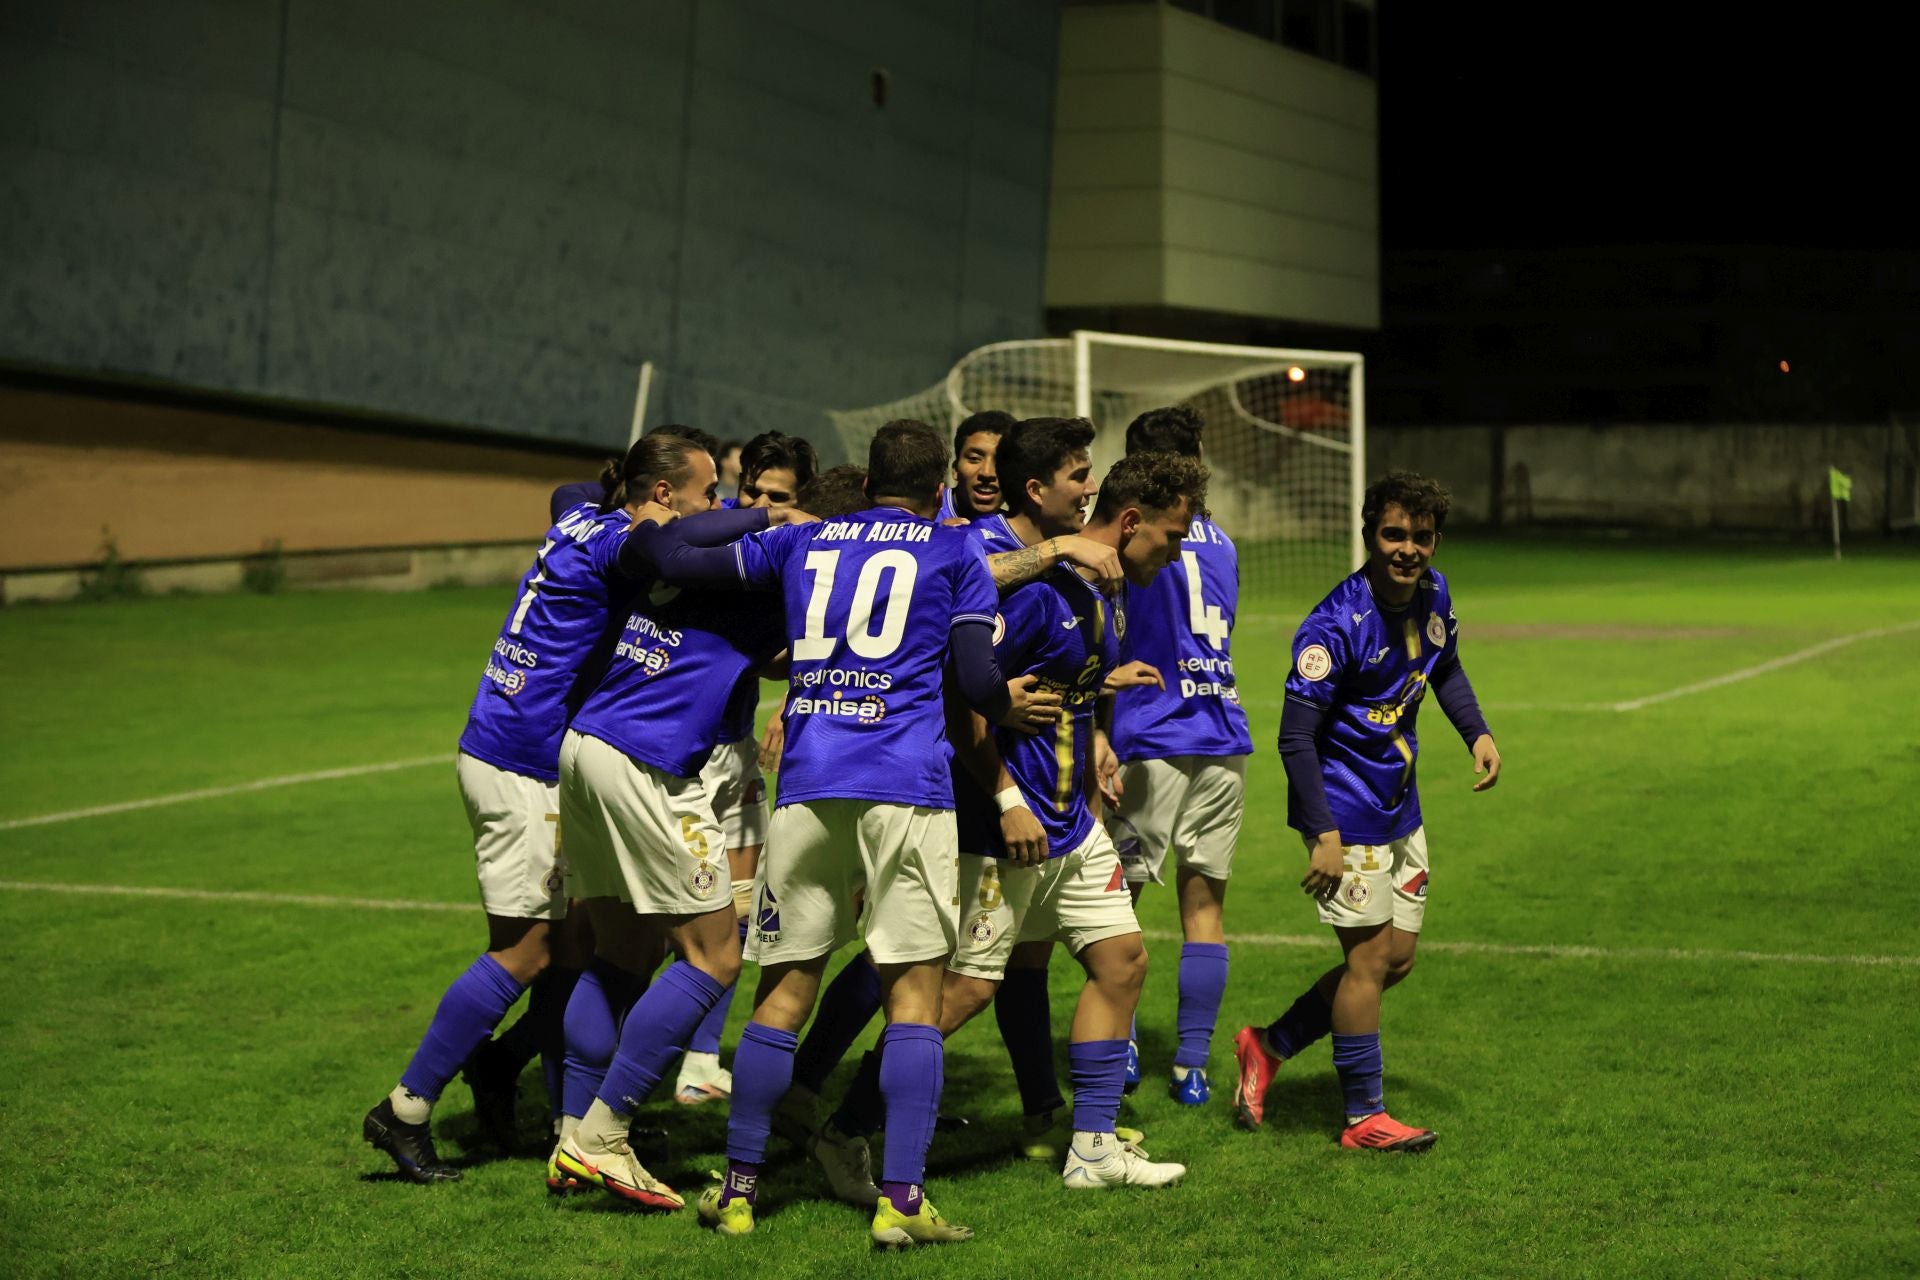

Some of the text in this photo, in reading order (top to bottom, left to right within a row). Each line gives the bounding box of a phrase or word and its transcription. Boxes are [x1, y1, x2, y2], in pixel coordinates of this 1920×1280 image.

[812, 520, 933, 542] RAN ADEVA
[792, 549, 918, 661] 10
[1180, 550, 1229, 651] 4
[615, 637, 663, 670] anisa
[681, 815, 708, 860] 5
